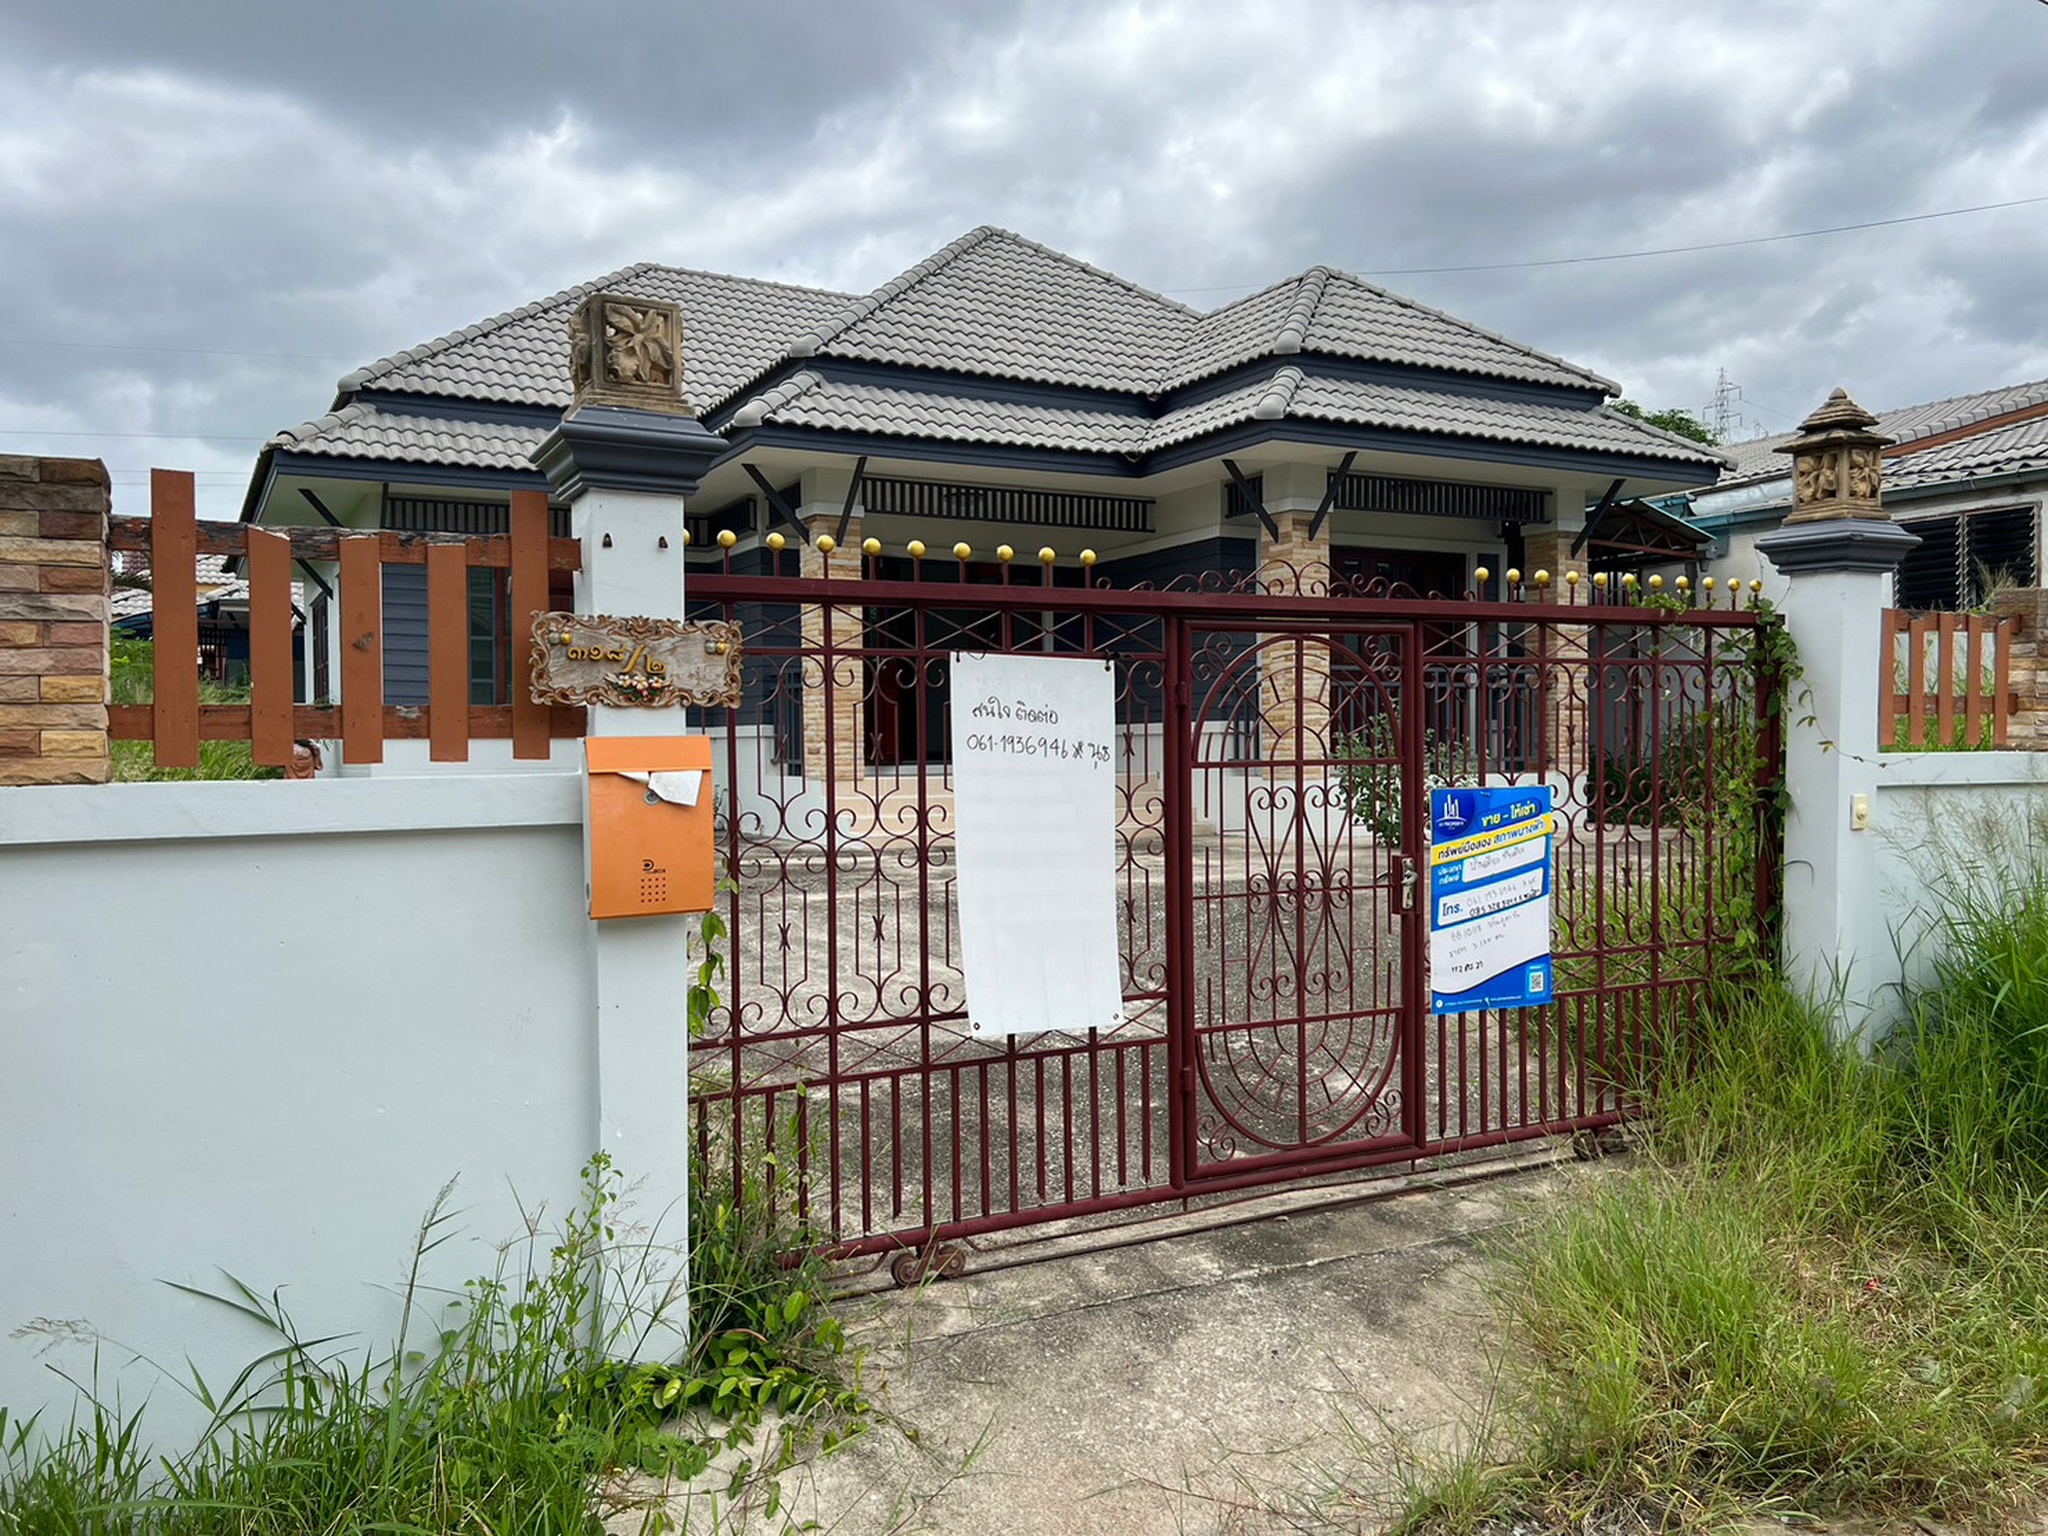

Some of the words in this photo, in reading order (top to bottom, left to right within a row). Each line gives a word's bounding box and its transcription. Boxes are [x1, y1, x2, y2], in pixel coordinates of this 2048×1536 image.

[972, 696, 1011, 719] สนใจ
[1015, 701, 1059, 724] ติดต่อ
[1481, 812, 1501, 827] ขาย
[1510, 801, 1537, 819] ให้เช่า
[1438, 838, 1492, 860] ทรัพย์มือสอง
[1442, 902, 1464, 917] โทร.
